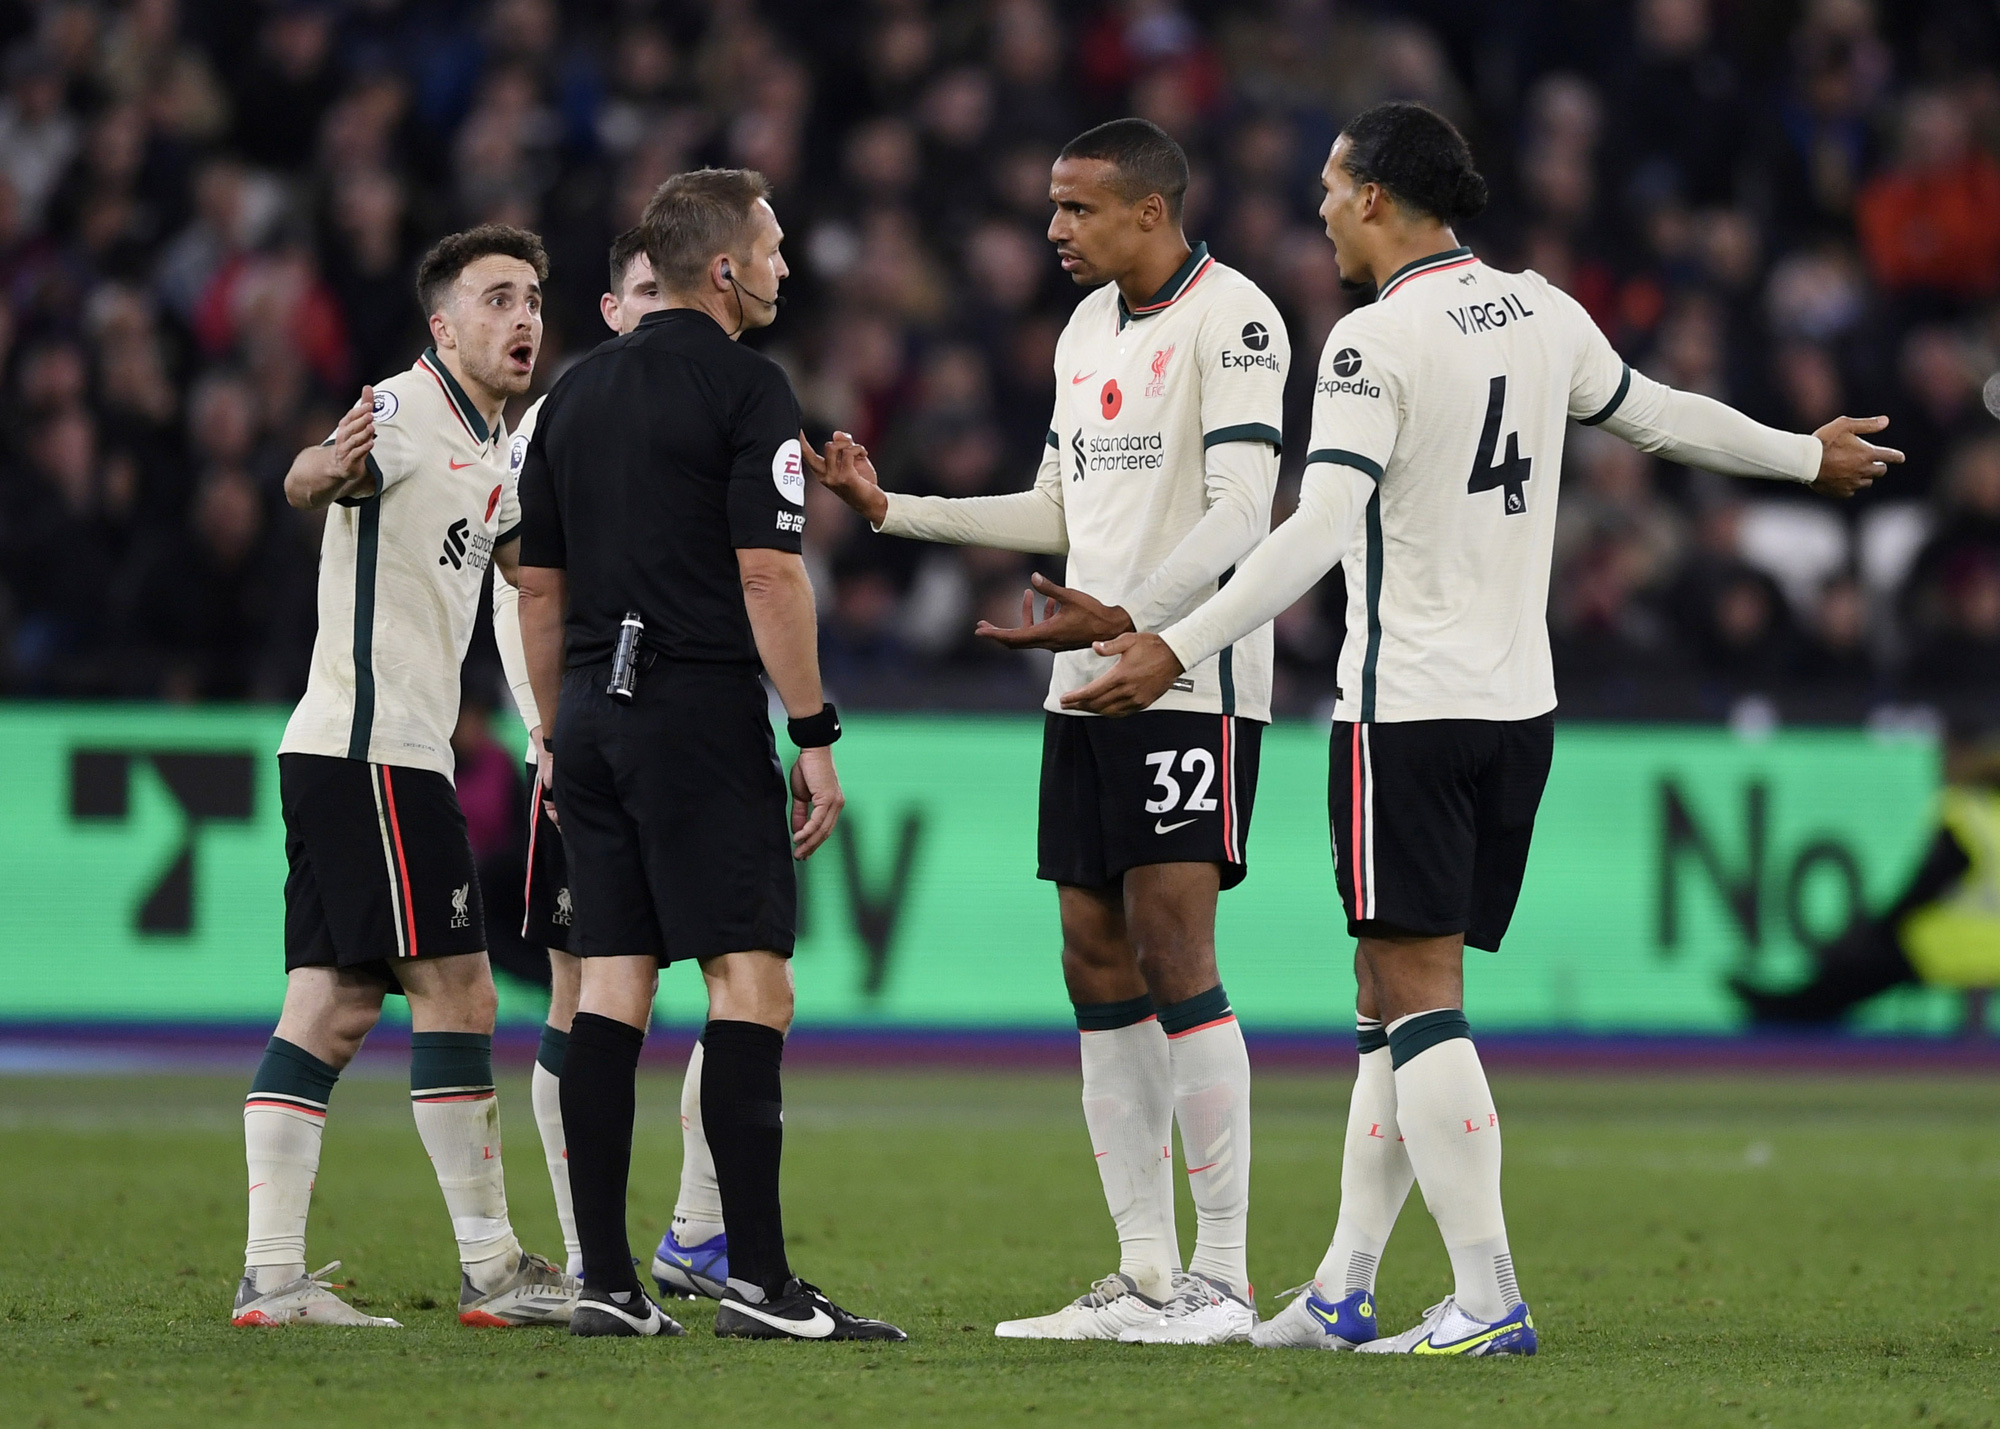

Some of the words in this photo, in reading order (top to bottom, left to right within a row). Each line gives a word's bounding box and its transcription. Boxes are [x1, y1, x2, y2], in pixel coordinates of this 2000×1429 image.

[1446, 293, 1534, 335] VIRGIL
[1317, 377, 1380, 399] Expedia
[1090, 431, 1162, 453] standard
[1467, 375, 1532, 515] 4
[784, 453, 801, 475] E
[1090, 450, 1165, 471] chartered
[782, 475, 803, 486] SPO
[776, 519, 791, 531] for
[777, 510, 793, 523] No
[1145, 748, 1218, 813] 32
